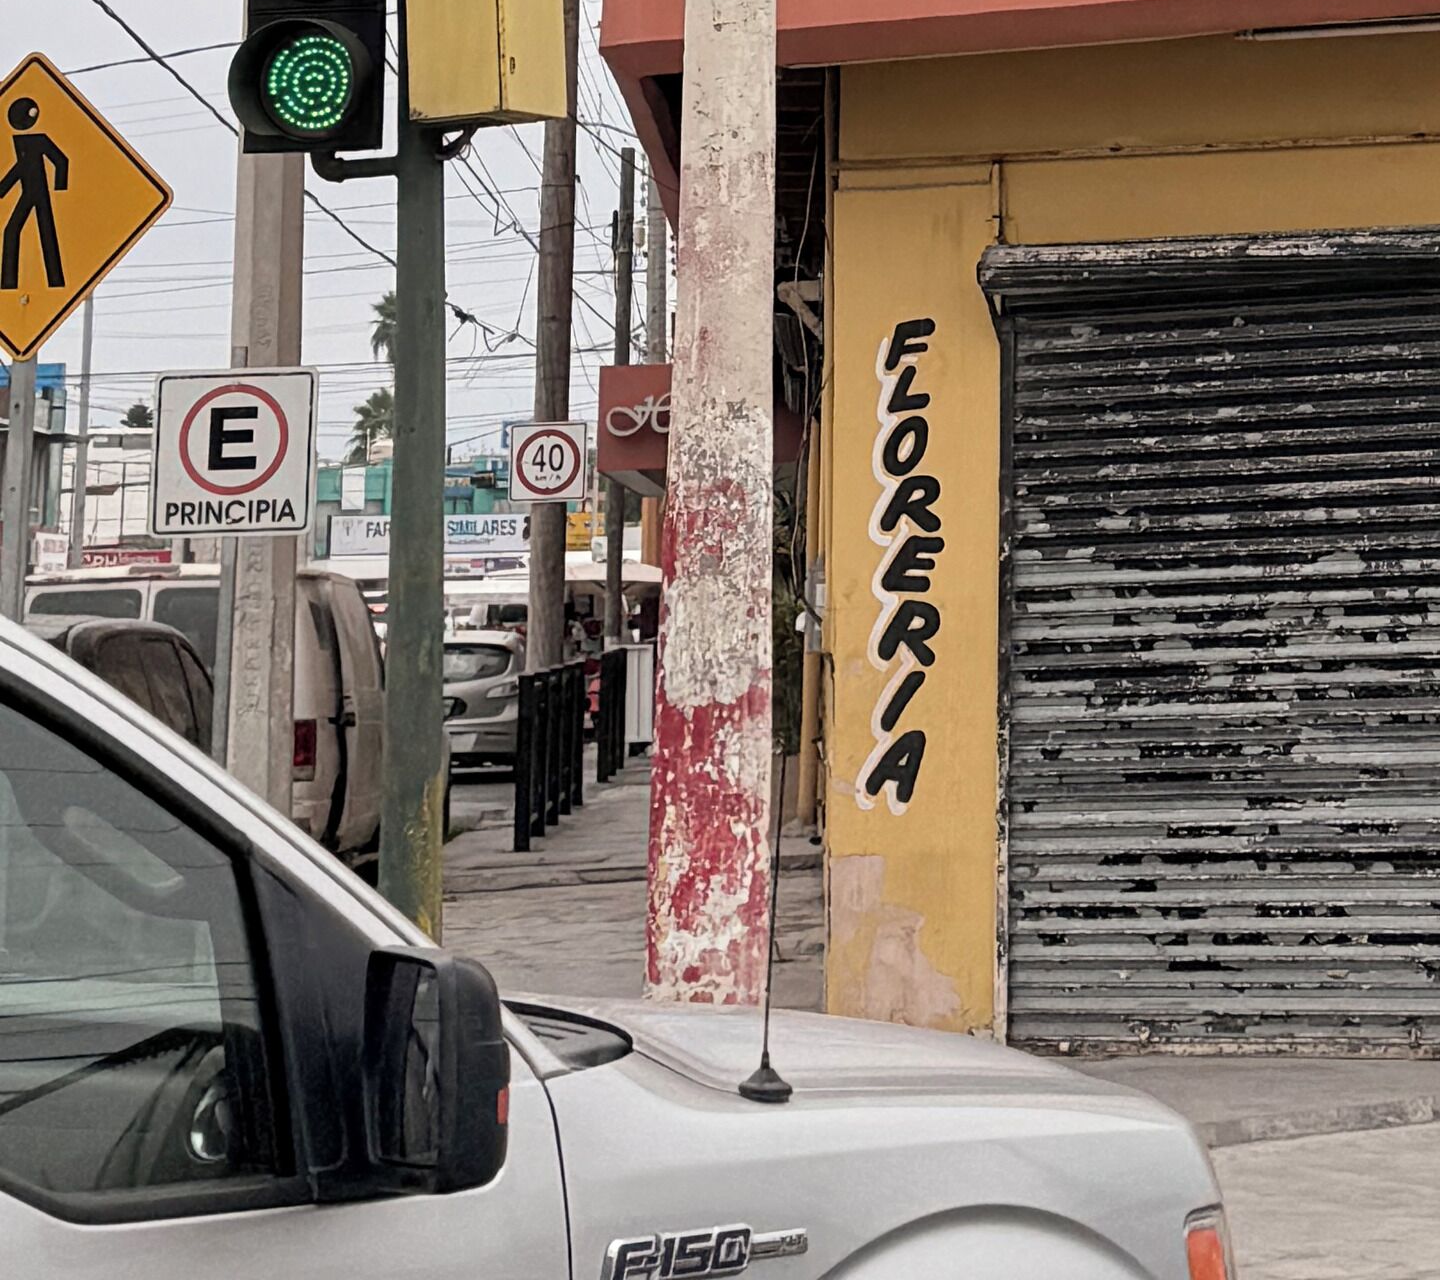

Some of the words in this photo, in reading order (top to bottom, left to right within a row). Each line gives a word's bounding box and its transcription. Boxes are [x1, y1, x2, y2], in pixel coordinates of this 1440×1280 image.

[208, 406, 258, 470] E
[531, 443, 565, 473] 40
[165, 498, 296, 526] PRINCIPIA
[860, 317, 945, 810] FLORERIA
[606, 1225, 752, 1280] F-150
